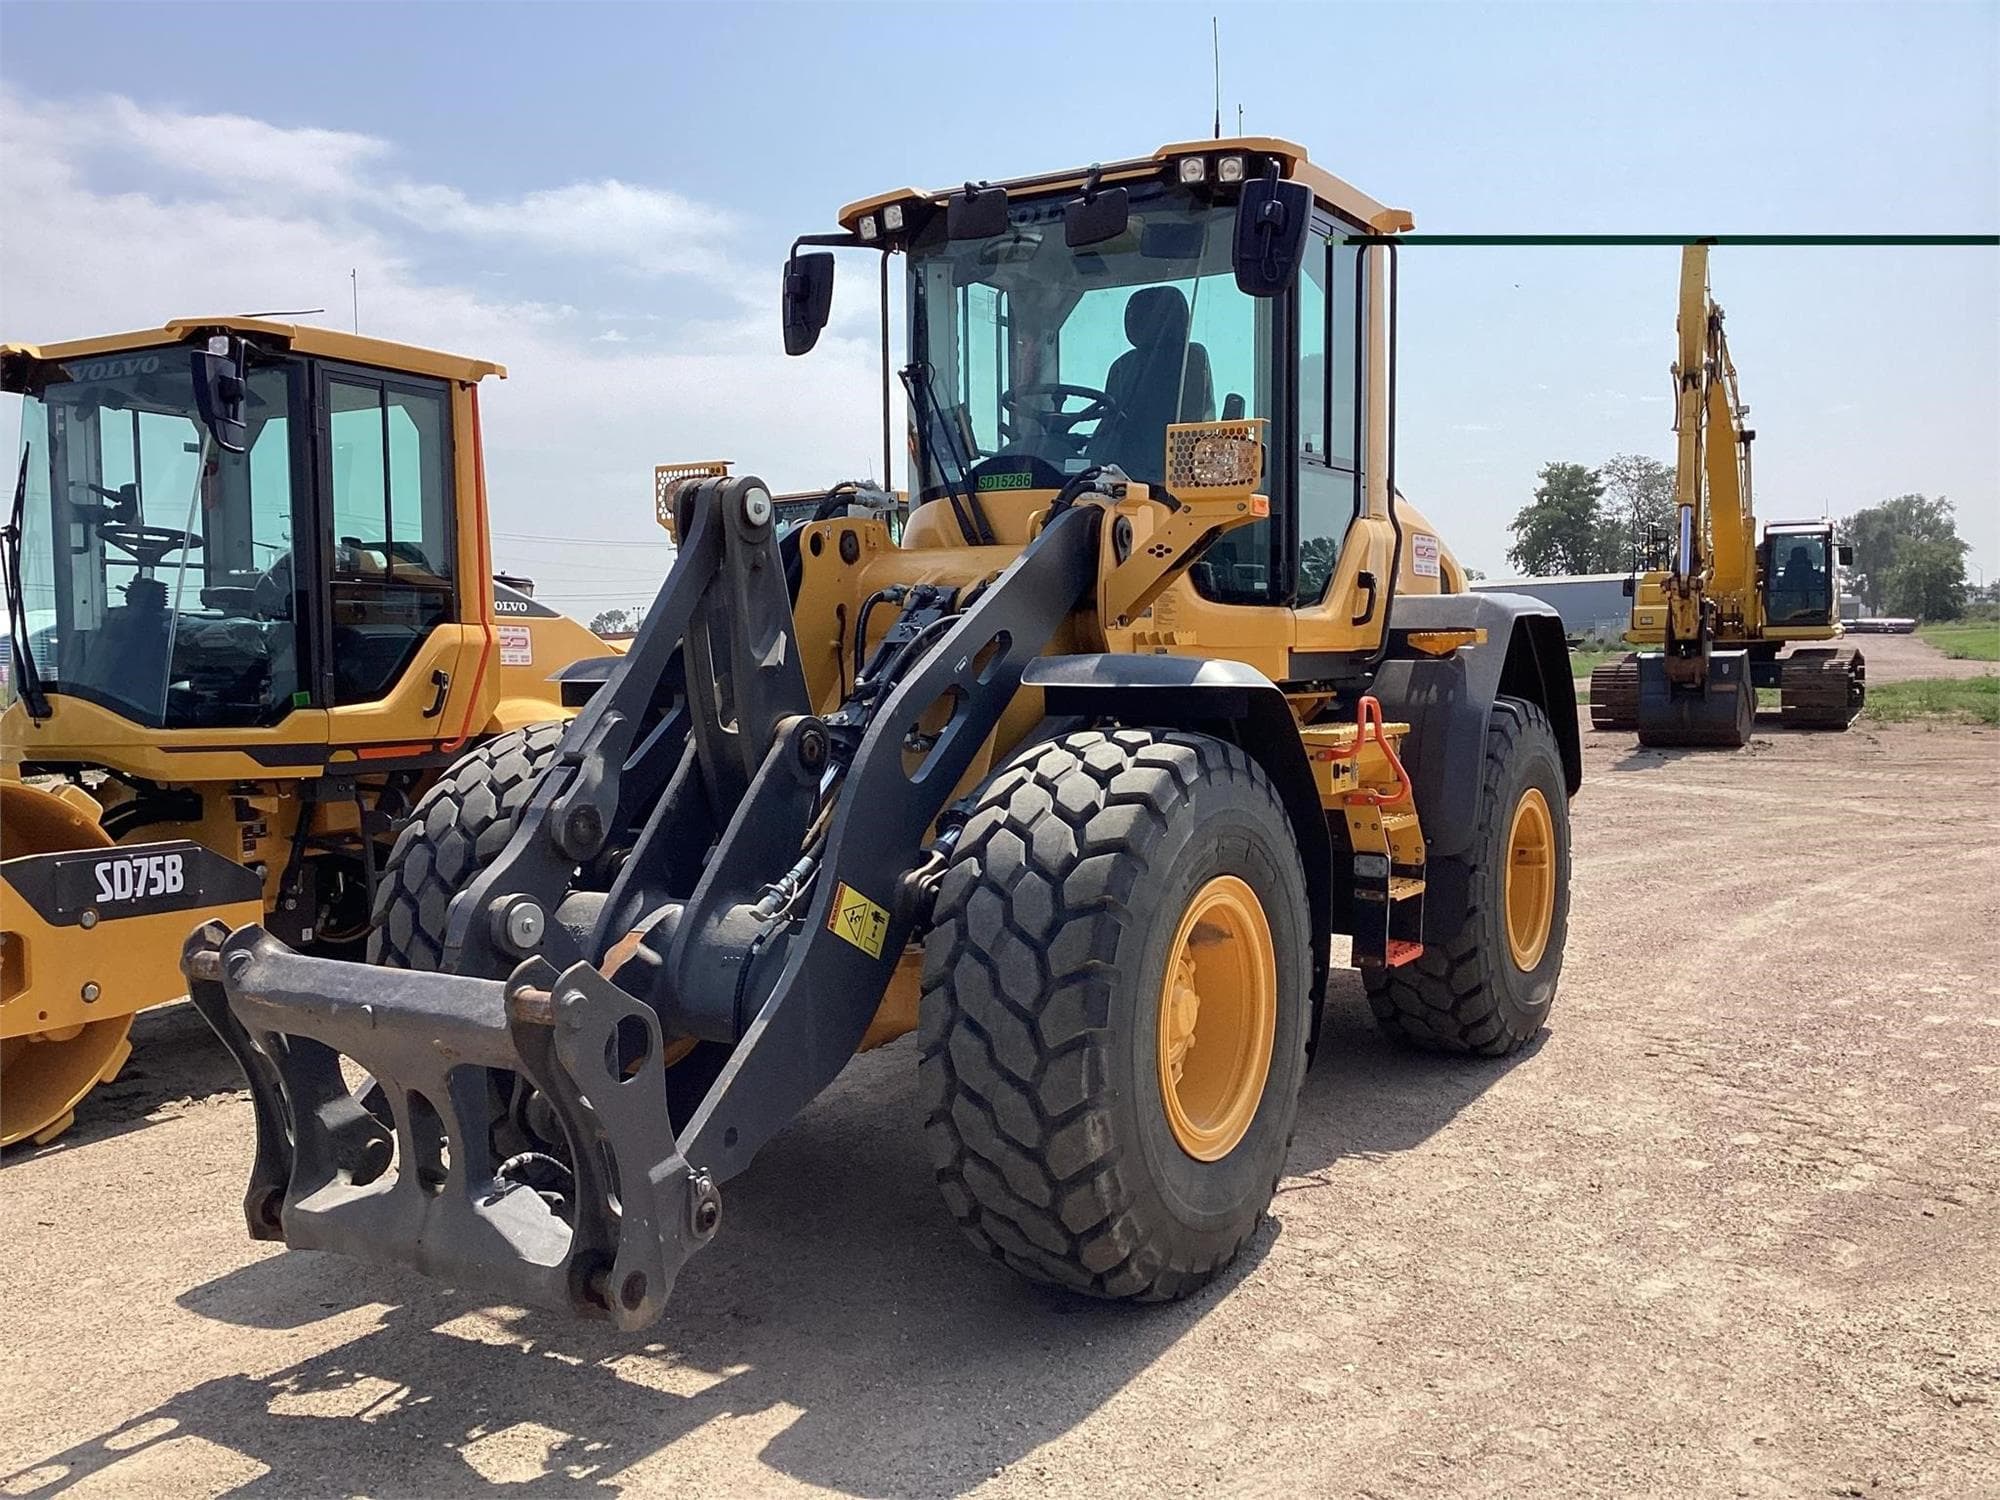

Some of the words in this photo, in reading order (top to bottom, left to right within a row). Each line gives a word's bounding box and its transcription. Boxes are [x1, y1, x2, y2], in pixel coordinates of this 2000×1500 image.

[71, 356, 160, 382] VOLVO
[979, 474, 1031, 489] SD15286
[495, 601, 528, 612] OLVO
[95, 854, 184, 903] SD75B
